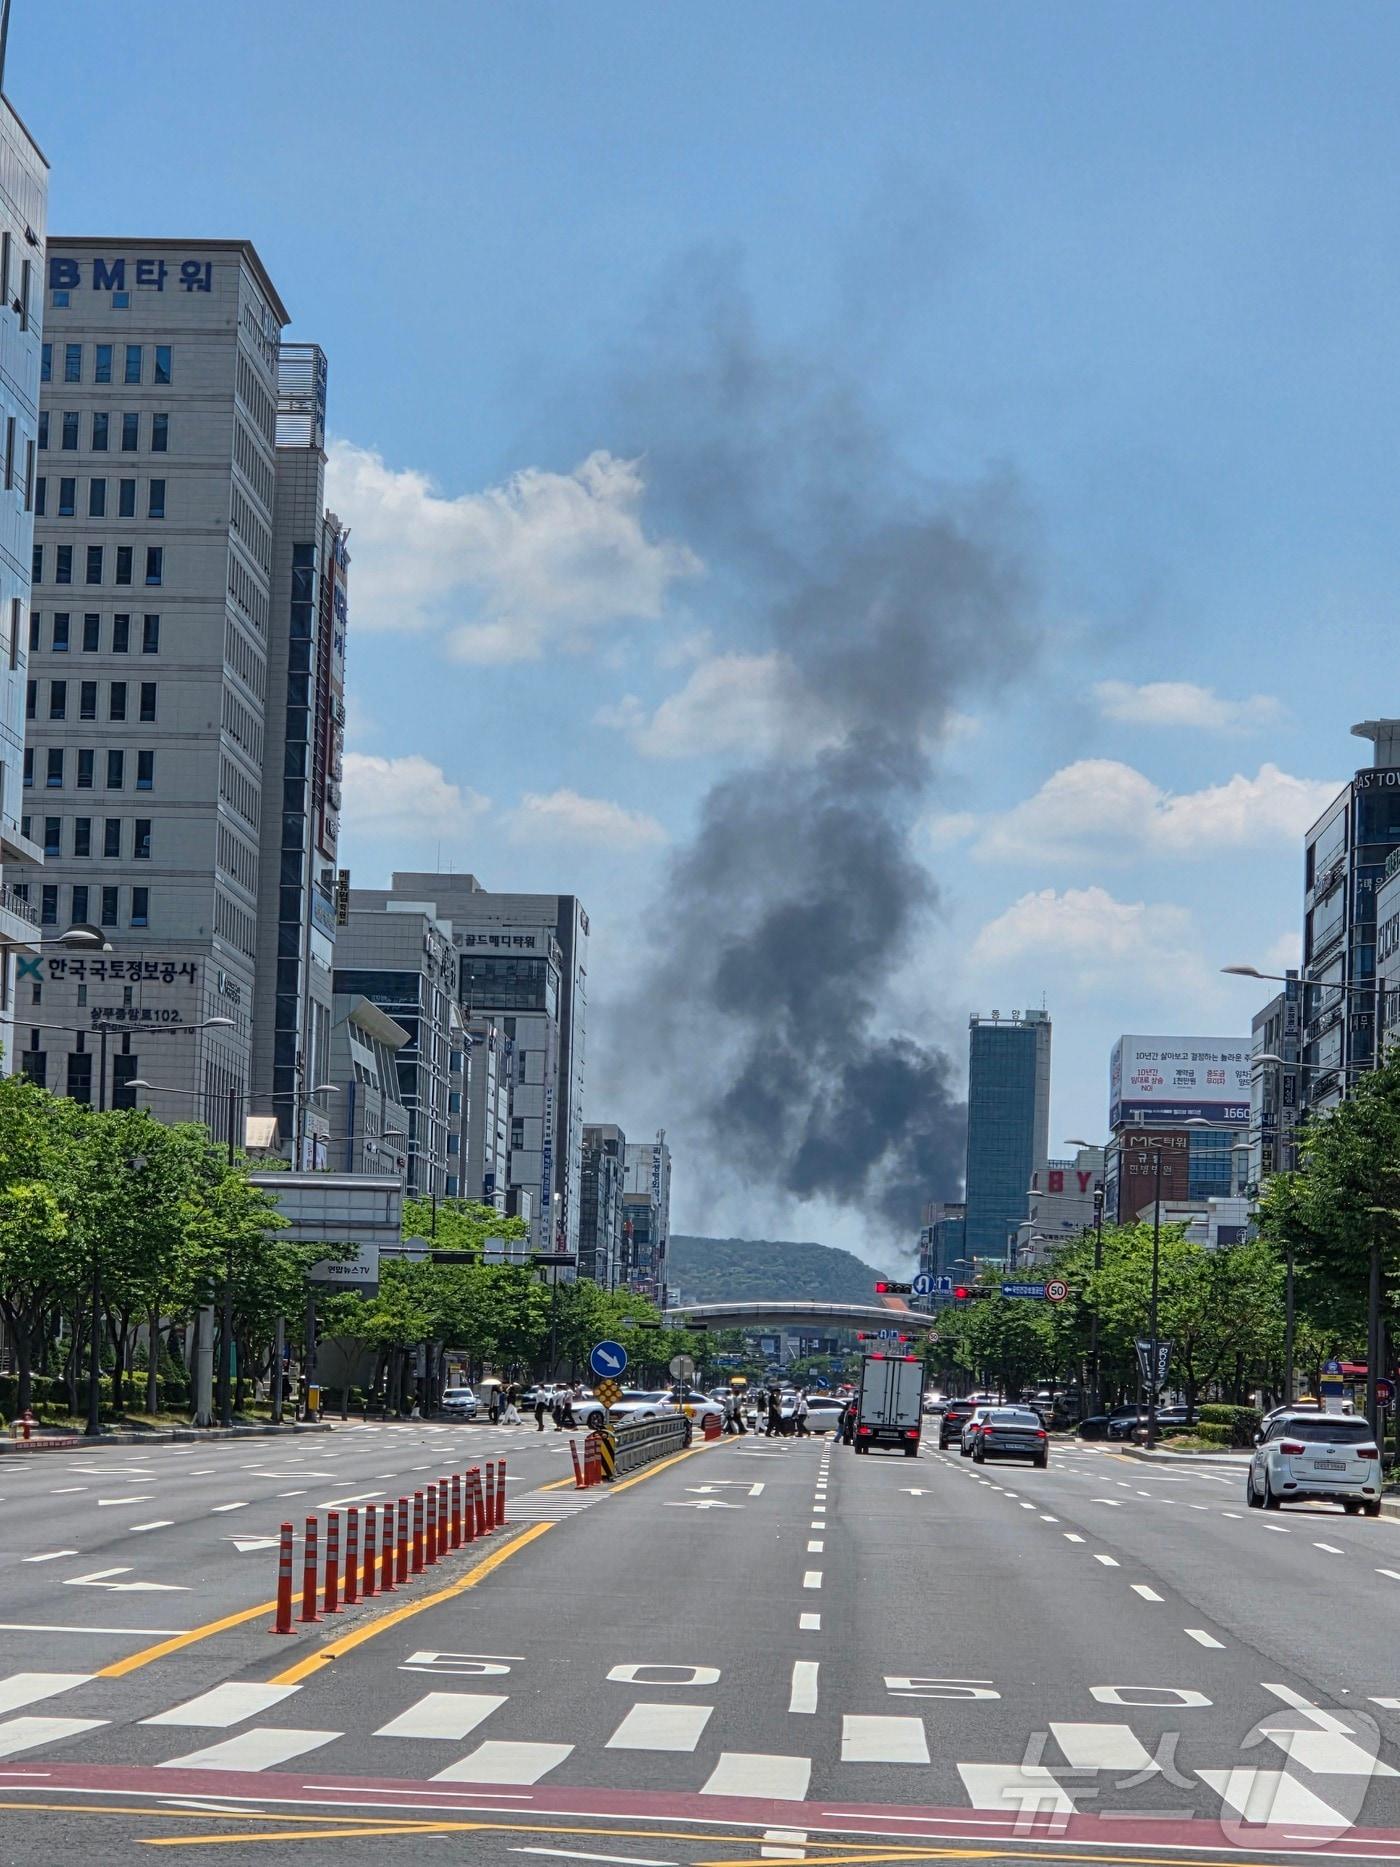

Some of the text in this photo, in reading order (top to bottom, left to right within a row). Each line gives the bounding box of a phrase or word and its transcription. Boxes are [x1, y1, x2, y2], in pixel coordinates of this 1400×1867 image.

[49, 257, 212, 293] BM타워
[465, 934, 535, 949] 골드메디타워
[48, 957, 198, 985] 한국국토정보공사
[1136, 1052, 1158, 1061] 10년간
[1160, 1052, 1189, 1061] 살아보고
[1191, 1053, 1218, 1062] 결정하는
[1220, 1053, 1242, 1062] 놀라운
[1175, 1069, 1195, 1078] 계약금
[1206, 1069, 1226, 1078] 중도금
[1130, 1136, 1187, 1148] MK타워
[327, 1265, 370, 1275] 연합뉴스TV
[1050, 1286, 1064, 1296] 50
